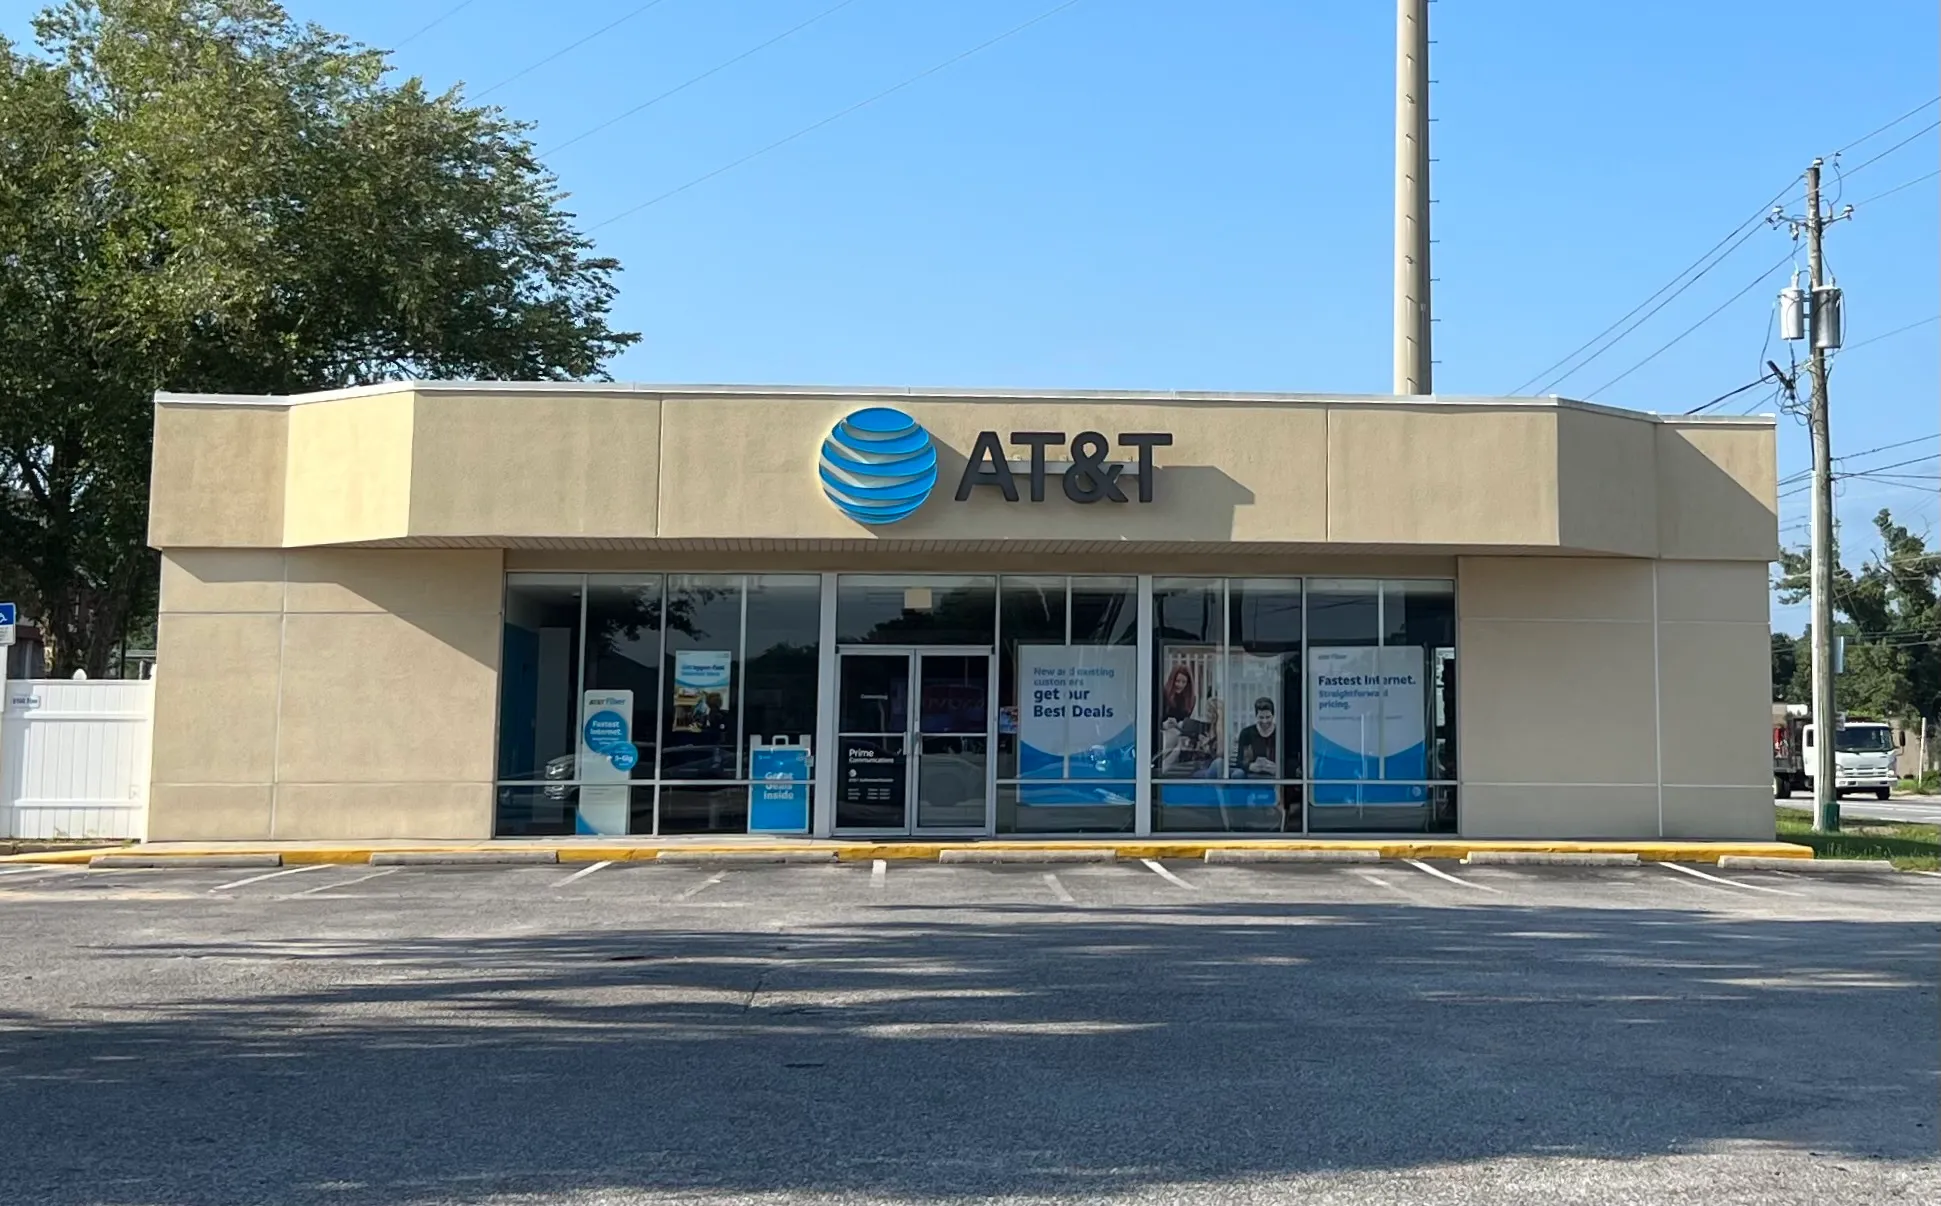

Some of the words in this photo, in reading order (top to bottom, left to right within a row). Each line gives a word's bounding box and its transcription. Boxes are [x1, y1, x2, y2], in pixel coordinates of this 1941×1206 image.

[955, 431, 1173, 504] AT&T
[1033, 667, 1055, 676] New
[1077, 667, 1115, 678] existing
[1318, 675, 1362, 686] Fastest
[1034, 688, 1060, 703] get
[1319, 689, 1388, 700] Straightforwad
[1034, 705, 1066, 718] Best
[1072, 704, 1114, 718] Deals
[1319, 700, 1351, 711] pricing.
[592, 720, 620, 728] Fastest
[849, 748, 875, 757] Prime
